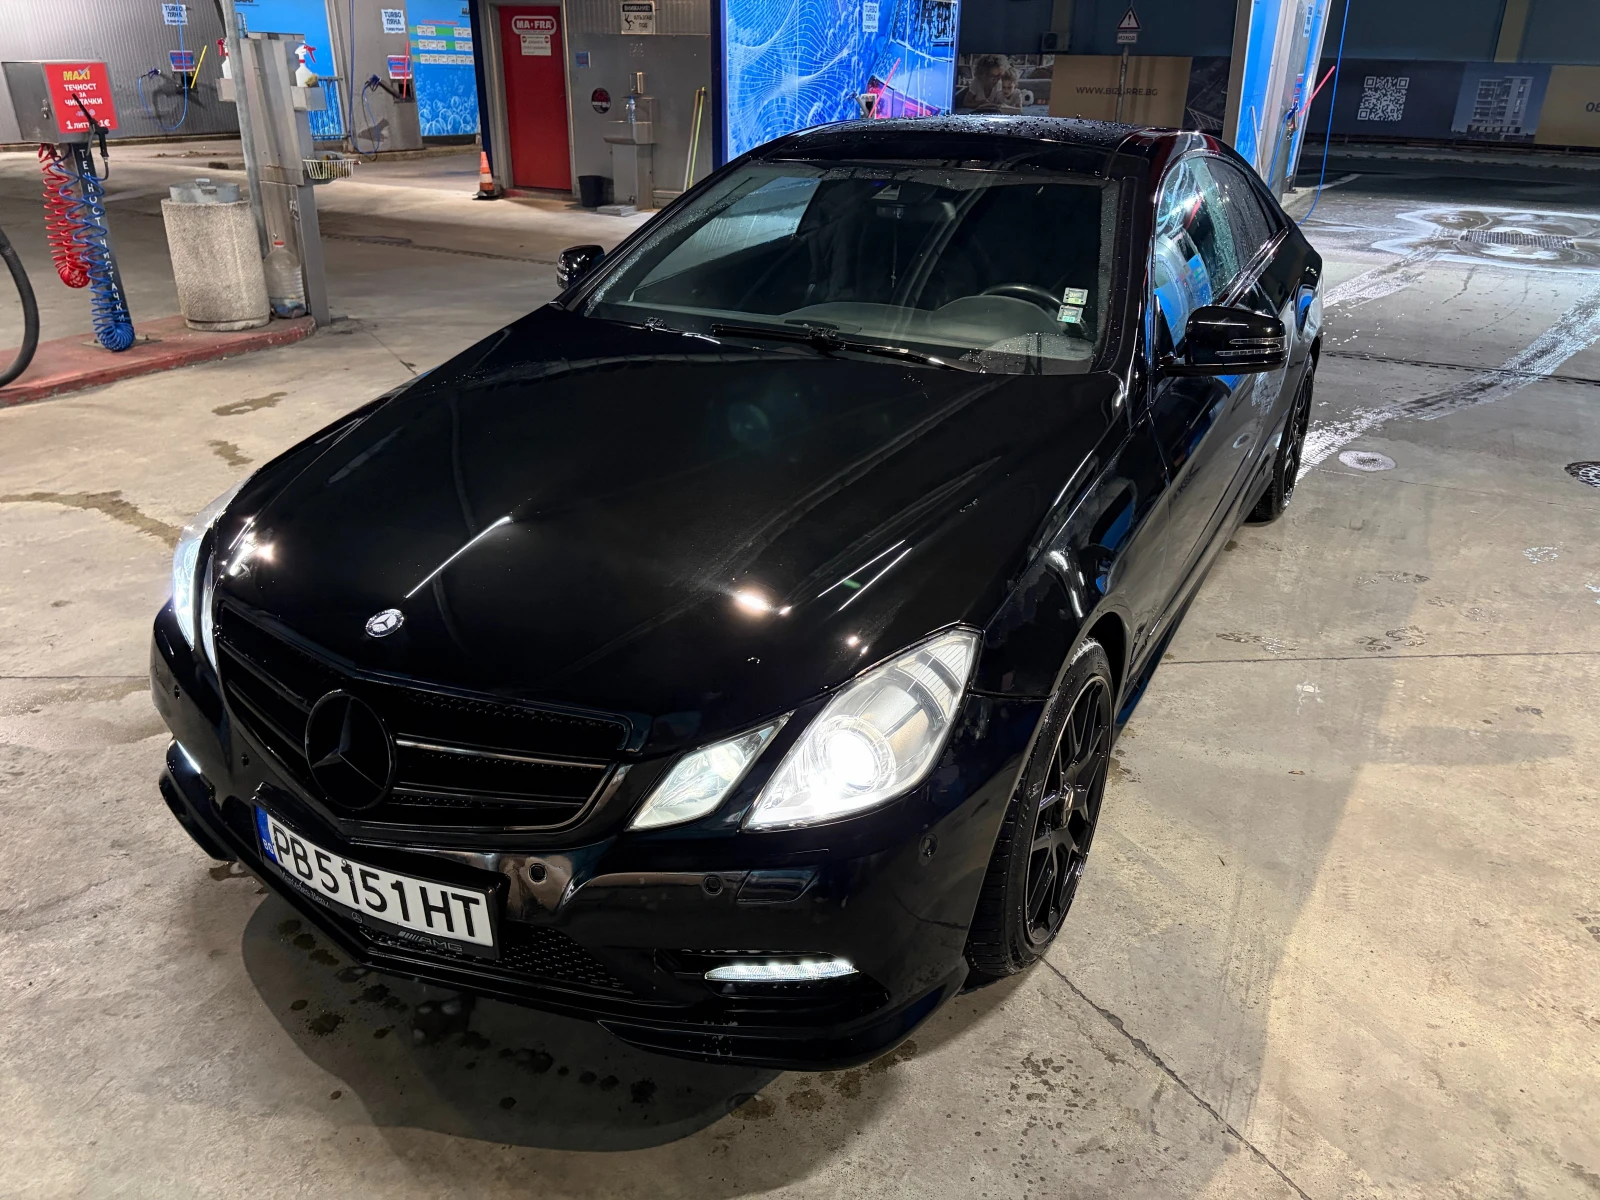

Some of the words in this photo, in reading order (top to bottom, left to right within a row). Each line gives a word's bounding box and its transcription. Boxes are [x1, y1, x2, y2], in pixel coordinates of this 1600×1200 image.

[63, 69, 90, 80] MAXI
[64, 83, 96, 91] ТЕЧНОСТ
[1076, 86, 1158, 96] WWW.BIZRRE.BG
[66, 120, 73, 129] 1
